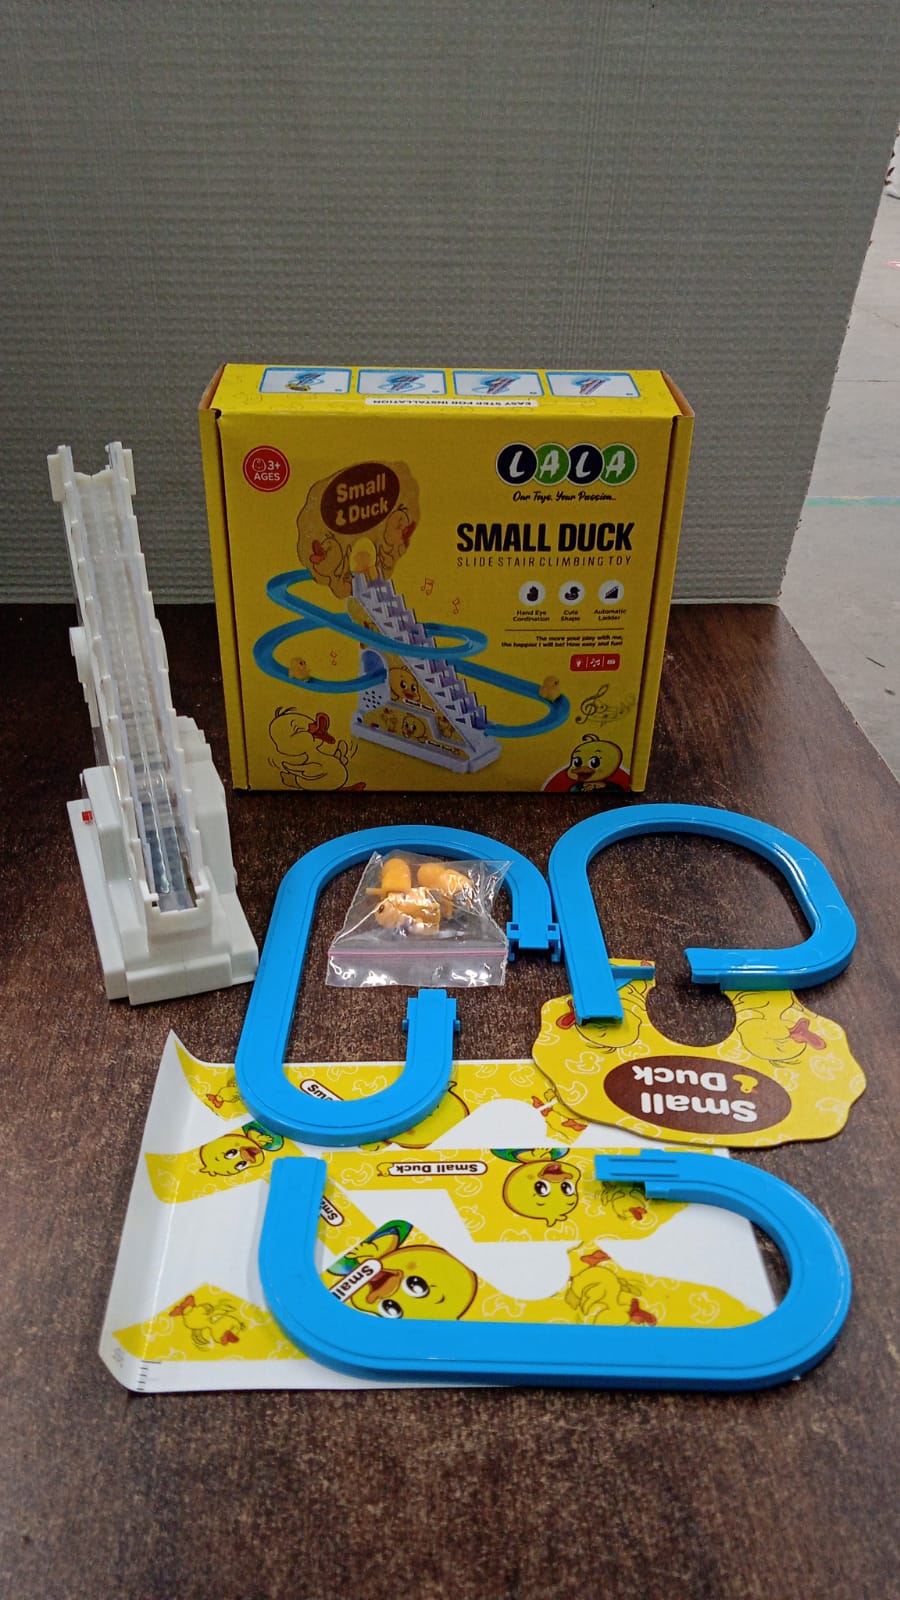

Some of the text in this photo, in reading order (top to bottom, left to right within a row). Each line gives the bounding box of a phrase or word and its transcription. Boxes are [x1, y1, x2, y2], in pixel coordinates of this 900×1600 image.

[254, 472, 281, 481] AGES
[268, 460, 281, 470] 3+
[505, 448, 628, 481] LALA
[336, 473, 387, 503] Small
[513, 491, 531, 502] Our
[556, 491, 576, 502] Your
[349, 497, 389, 524] Duck
[457, 522, 635, 552] SMALL DUCK
[457, 555, 632, 567] SLIDE STAIR CLIMBING TOY
[535, 609, 547, 617] Eye
[632, 1065, 728, 1092] Duck
[640, 1092, 758, 1123] Small
[395, 1163, 479, 1173] Small Duck
[332, 1265, 374, 1300] Small
